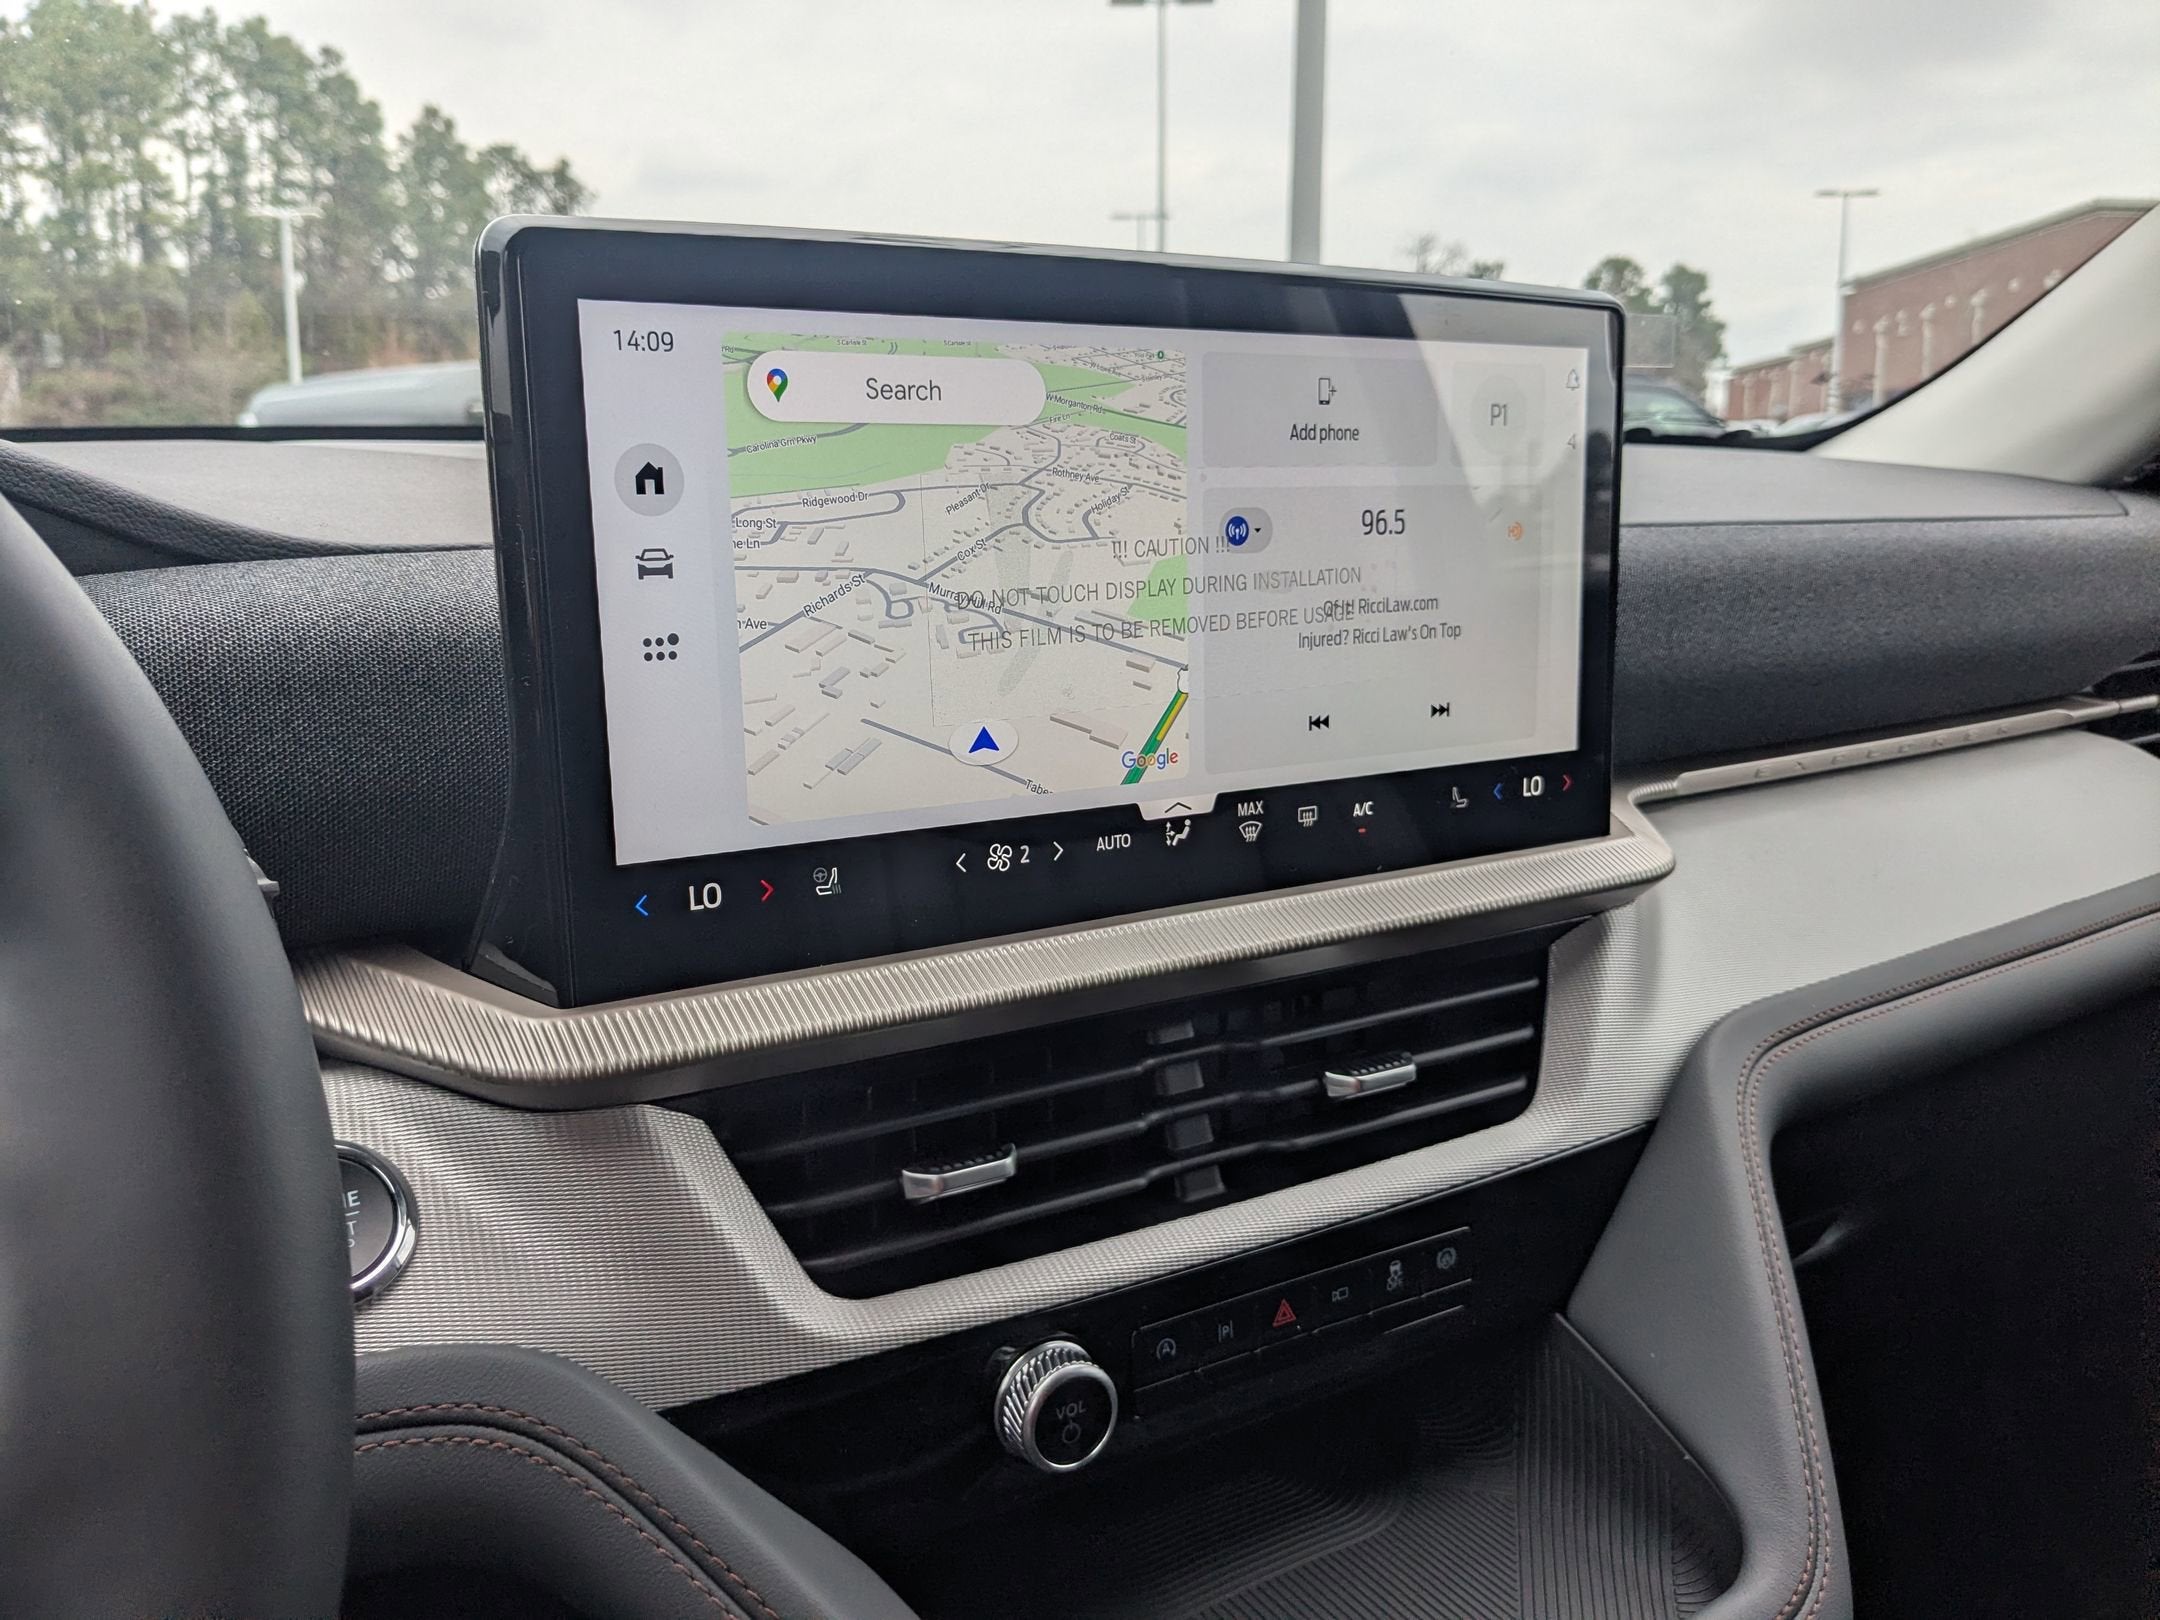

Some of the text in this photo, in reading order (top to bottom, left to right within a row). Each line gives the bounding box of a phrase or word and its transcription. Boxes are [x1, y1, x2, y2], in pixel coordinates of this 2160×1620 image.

[613, 330, 674, 352] 14:09
[865, 377, 942, 401] Search
[1045, 393, 1103, 414] W Morganton Rd
[1489, 404, 1509, 426] P1
[746, 435, 817, 453] Carolina Grn Pkwy
[1109, 432, 1128, 443] Coats
[1290, 423, 1360, 444] Add phone
[1052, 467, 1101, 483] Rothney Ave
[802, 491, 870, 508] Ridgewood Dr
[945, 482, 991, 516] Pleasant Dr
[1090, 486, 1131, 514] Holiday St
[735, 517, 777, 531] Long St
[1361, 508, 1406, 536] 96.5
[746, 537, 760, 549] Ln
[957, 537, 987, 561] Cox St
[1134, 537, 1209, 558] CAUTION
[803, 574, 866, 617] Richards St
[957, 566, 1362, 609] DO NOT TOUCH DISPLAY DURING INSTALLATION
[987, 600, 1002, 615] Rd
[1358, 596, 1439, 615] RicciLaw.com
[744, 616, 767, 630] Ave
[967, 604, 1355, 652] THIS FILM IS TO BE REMOVED BEFORE USAGE
[1298, 621, 1462, 651] Injured? Ricci Law's On Top
[1121, 747, 1179, 770] Google
[1522, 776, 1544, 798] LO
[1237, 801, 1264, 817] MAX
[1352, 801, 1375, 818] A/C
[1096, 833, 1131, 851] AUTO
[1020, 845, 1031, 864] 2
[688, 882, 723, 912] LO
[1055, 1400, 1088, 1420] VOL
